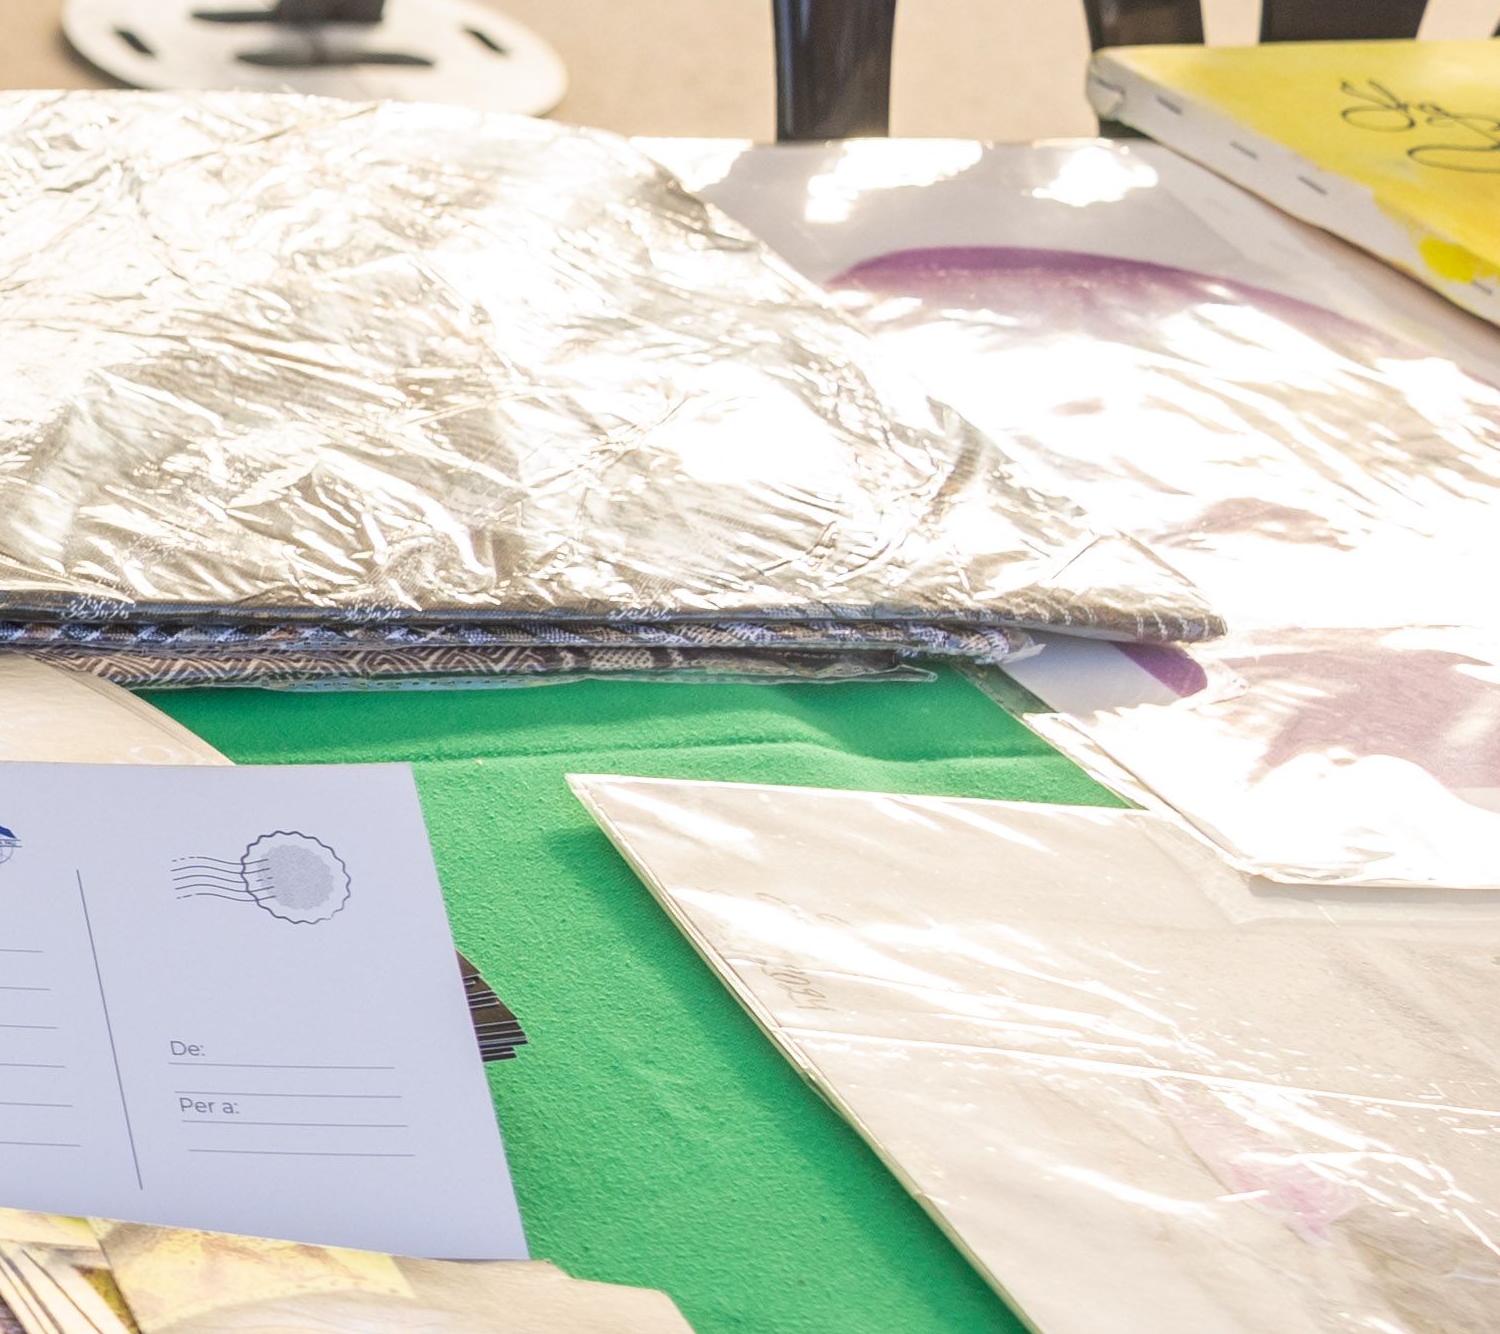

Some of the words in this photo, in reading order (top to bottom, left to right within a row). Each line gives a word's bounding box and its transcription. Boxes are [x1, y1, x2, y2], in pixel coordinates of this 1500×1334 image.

[170, 1040, 205, 1056] De:
[179, 1097, 215, 1113] Per
[222, 1101, 239, 1114] a:
